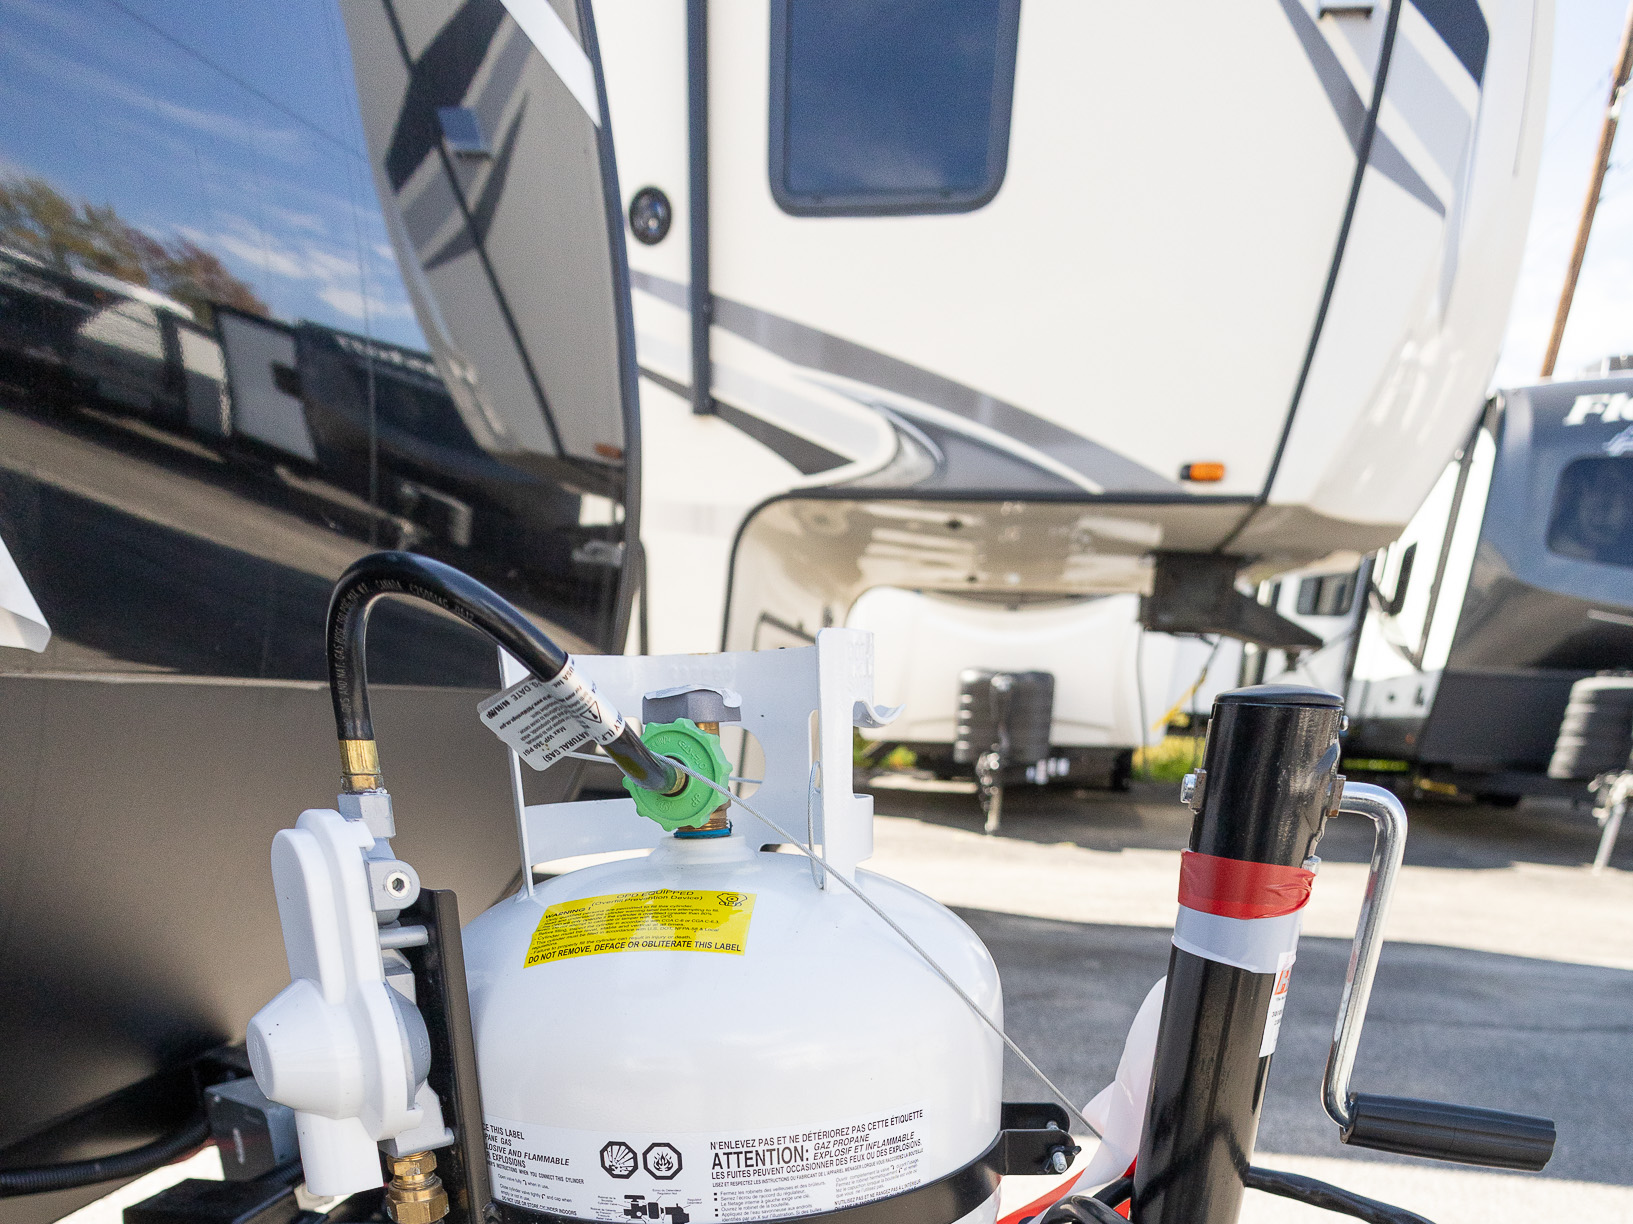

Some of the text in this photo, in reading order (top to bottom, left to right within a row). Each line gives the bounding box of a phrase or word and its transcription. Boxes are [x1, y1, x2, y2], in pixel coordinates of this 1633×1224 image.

[510, 685, 532, 701] DATE
[544, 734, 555, 743] WP
[553, 726, 567, 736] Max
[542, 749, 561, 762] GAS)
[528, 955, 539, 964] DO
[540, 951, 556, 961] NOT
[557, 945, 592, 957] REMOVE,
[593, 941, 626, 952] DEFACE
[627, 940, 639, 949] OR
[642, 940, 693, 948] OBLITERATE
[694, 941, 713, 949] THIS
[714, 942, 741, 952] LABEL
[490, 1125, 504, 1136] THIS
[505, 1128, 525, 1140] LABEL
[710, 1109, 923, 1151] N'ENLEVEZ PAS ET NE DÉTÉRIOREZ PAS CETTE ÉTIQUETTE
[500, 1137, 512, 1147] GAS
[813, 1133, 870, 1151] GAZ PROPANE
[813, 1131, 915, 1161] EXPLOSIF ET INFLAMMABLE
[492, 1152, 526, 1169] EXPLOSIONS
[508, 1148, 522, 1158] AND
[524, 1152, 570, 1166] FLAMMABLE
[711, 1144, 809, 1170] ATTENTION:
[711, 1171, 725, 1180] LES
[726, 1169, 752, 1179] FUITES
[752, 1166, 784, 1177] PEUVENT
[786, 1159, 834, 1174] OCCASIONNER
[835, 1157, 848, 1166] DES
[849, 1153, 865, 1163] FEUX
[866, 1151, 875, 1160] OU
[876, 1148, 888, 1158] DES
[519, 1168, 529, 1176] WHEN
[565, 1177, 585, 1185] CYLINDER
[730, 1179, 753, 1187] RESPECTEZ
[762, 1176, 789, 1184] INSTRUCTIONS
